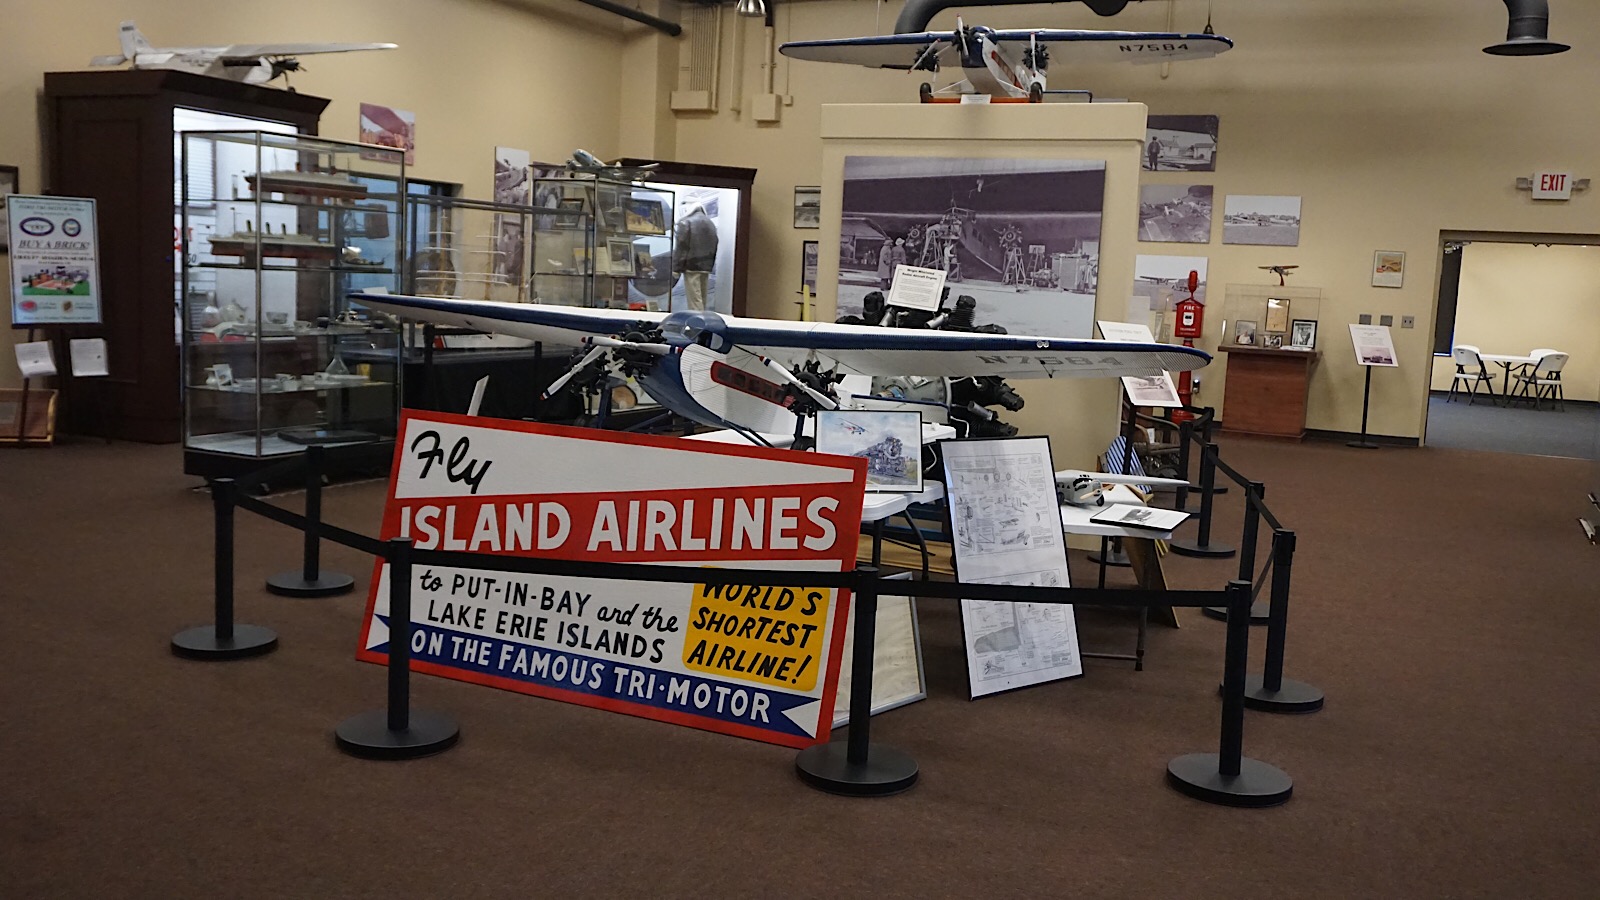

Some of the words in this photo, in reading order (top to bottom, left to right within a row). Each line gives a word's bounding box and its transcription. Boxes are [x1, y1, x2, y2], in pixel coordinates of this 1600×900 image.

[1119, 43, 1189, 52] N7584
[1541, 174, 1567, 191] EXIT
[18, 240, 40, 249] BUY
[45, 241, 51, 249] A
[411, 430, 492, 494] Fly
[401, 501, 571, 551] ISLAND
[587, 496, 840, 551] AIRLINES
[420, 569, 442, 591] to
[451, 574, 591, 617] PUT-IN-BAY
[597, 603, 640, 627] and
[642, 606, 679, 632] the
[428, 600, 486, 629] LAKE
[496, 611, 548, 641] ERIE
[557, 621, 665, 664] ISLANDS
[693, 606, 818, 649] SHORTEST
[411, 630, 443, 656] ON
[451, 637, 492, 666] THE
[498, 643, 605, 690] FAMOUS
[687, 639, 813, 684] AIRLINE!
